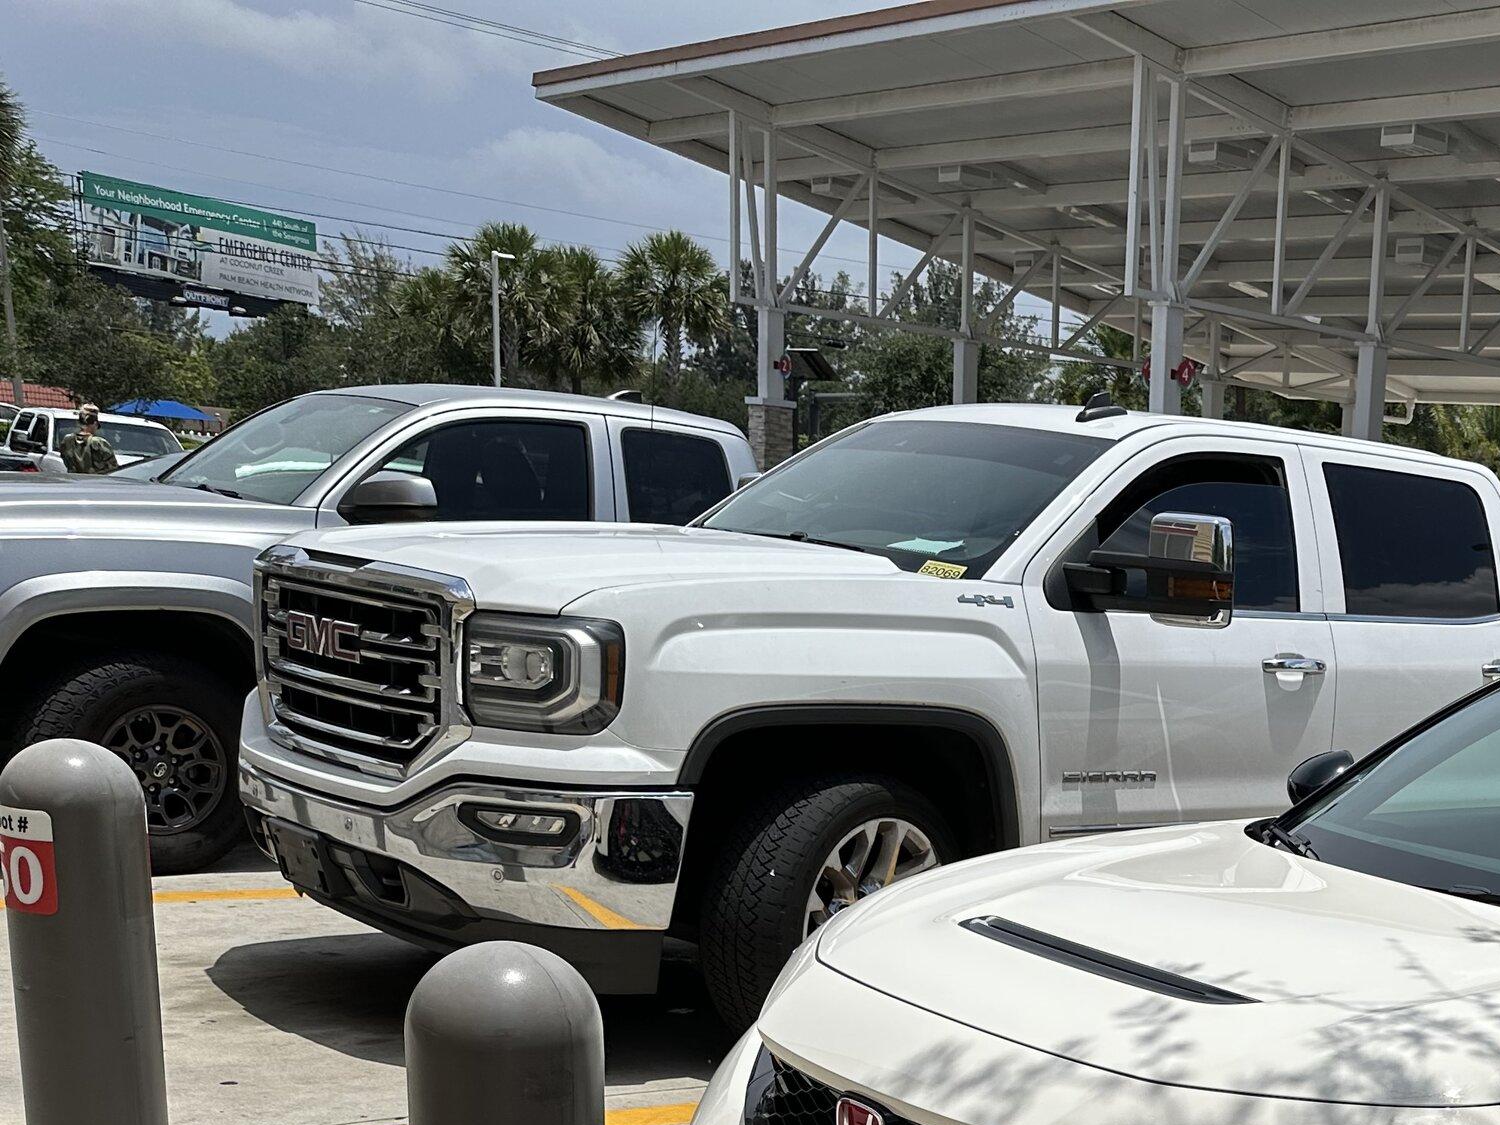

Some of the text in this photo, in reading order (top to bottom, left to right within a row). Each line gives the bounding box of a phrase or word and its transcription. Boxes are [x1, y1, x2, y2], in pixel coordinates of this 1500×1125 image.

[93, 183, 261, 228] Your Neighborhood Emergency Center
[219, 237, 313, 273] EMERGENCY CENTER
[219, 256, 285, 276] AT COCONUT CREEK
[219, 272, 314, 298] PALM BEACH HEALTH NETWORK
[1182, 367, 1189, 381] 4
[920, 565, 961, 580] 82069
[287, 610, 360, 664] GMC
[1062, 770, 1157, 784] SIERRA
[17, 816, 29, 834] #
